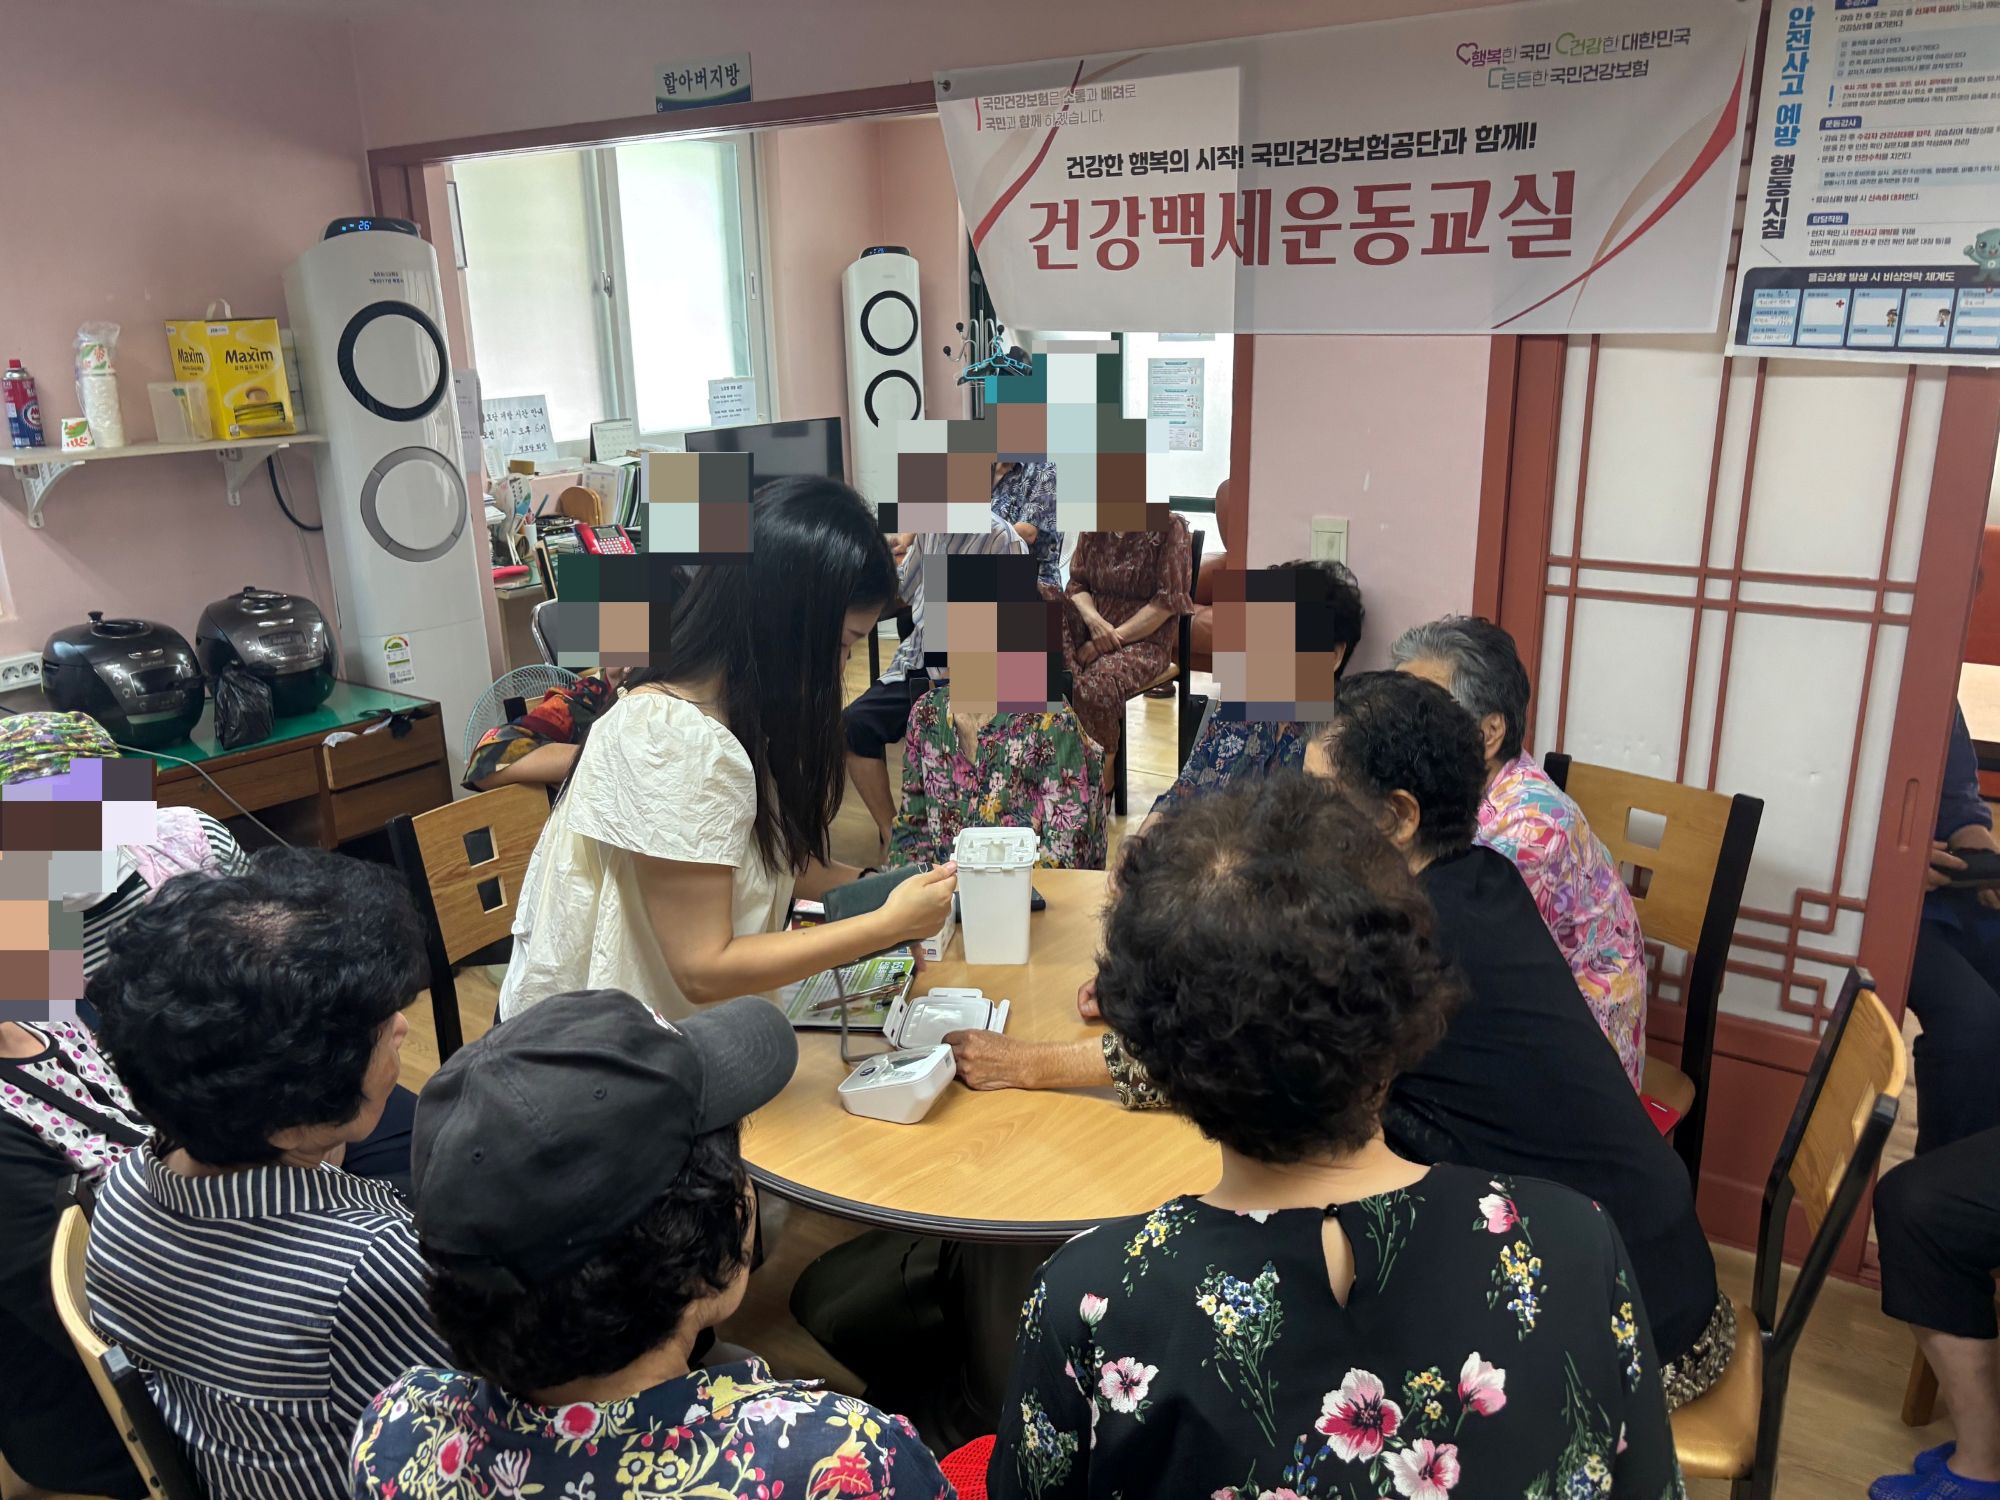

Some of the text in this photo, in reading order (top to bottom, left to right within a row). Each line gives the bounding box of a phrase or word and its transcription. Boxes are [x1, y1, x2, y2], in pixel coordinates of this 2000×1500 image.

[1463, 27, 1691, 67] 행복한 국민 건강한 대한민국
[663, 63, 740, 95] 할아버지방
[1550, 59, 1650, 84] 국민건강보험
[1774, 6, 1815, 147] 안전사고 예방
[983, 91, 1060, 111] 국민건강보험은
[1101, 83, 1137, 101] 배려로
[985, 116, 1016, 131] 국민과
[1019, 114, 1042, 129] 함께
[1066, 121, 1537, 180] 건강한 행복의 시작! 국민건강보험공단과 함께!
[1761, 154, 1796, 240] 행동지침
[1028, 170, 1576, 271] 건강백세운동교실
[1848, 272, 1869, 282] 발생
[1870, 272, 1880, 282] 시
[1883, 272, 1923, 282] 비상연락
[177, 347, 205, 364] Maxim
[225, 346, 274, 364] Maxim
